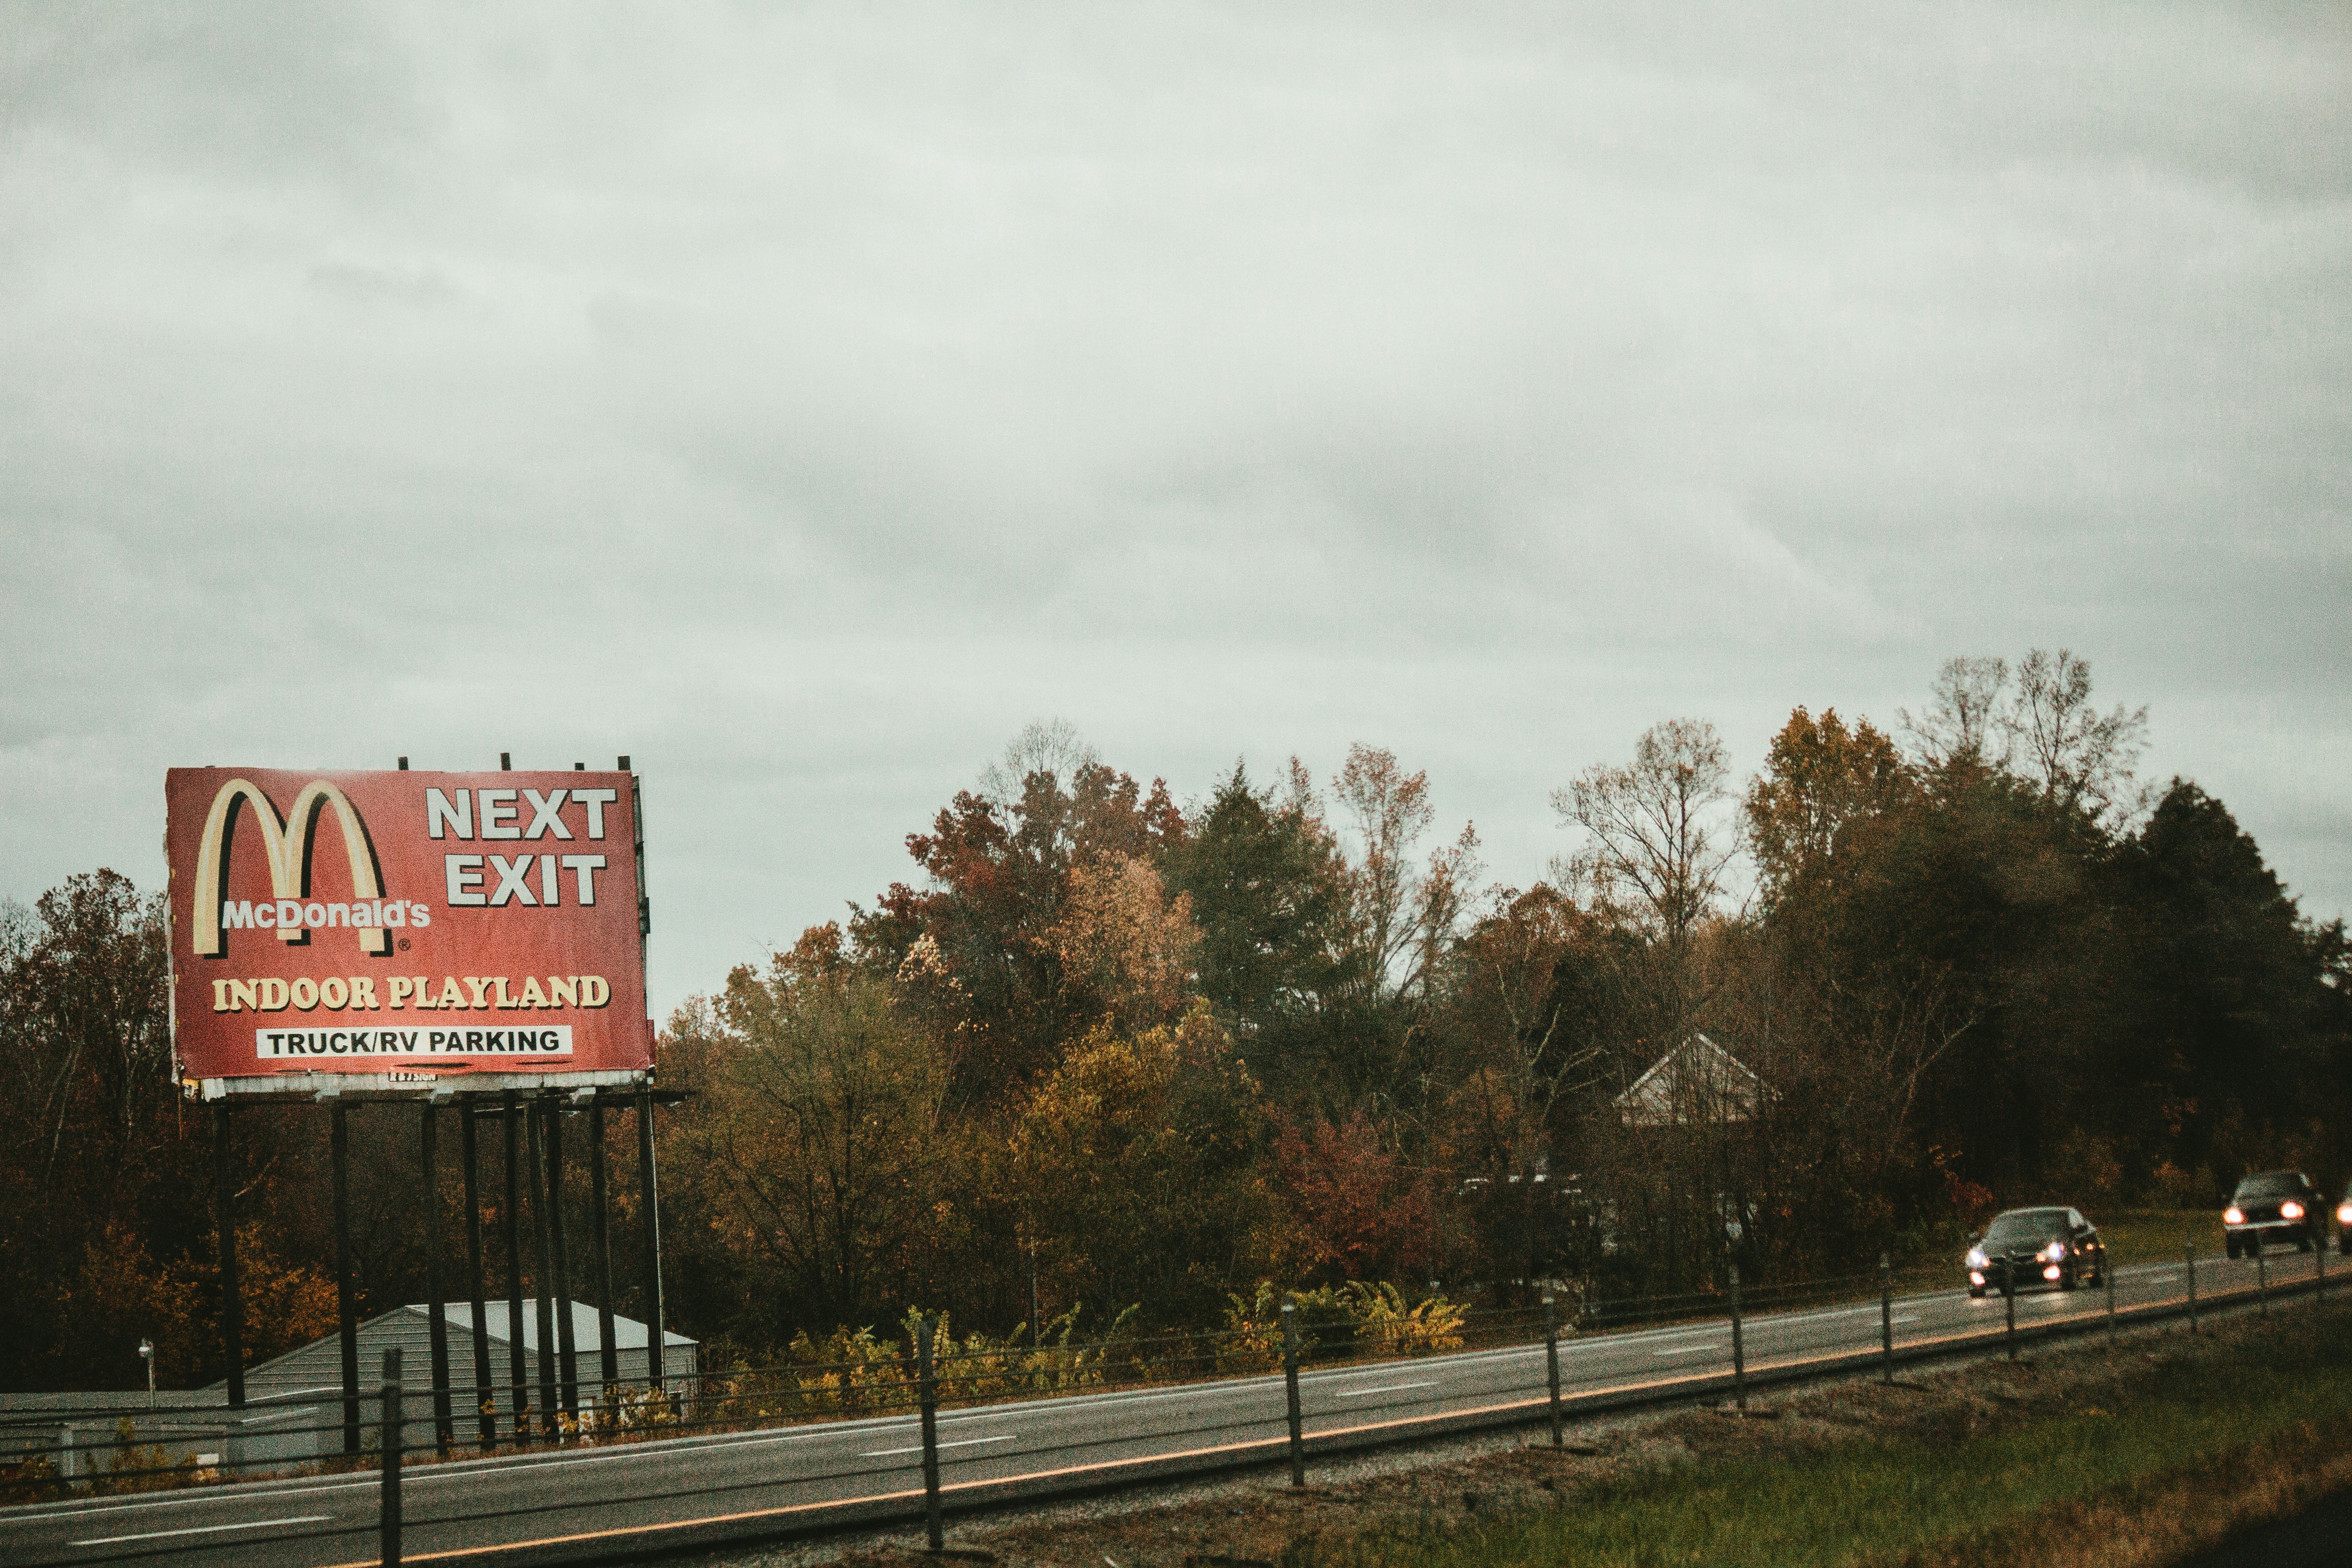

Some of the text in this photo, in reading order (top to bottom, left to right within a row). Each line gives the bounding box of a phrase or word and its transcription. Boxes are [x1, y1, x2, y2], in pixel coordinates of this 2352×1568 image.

[426, 788, 617, 840] NEXT
[445, 854, 608, 907] EXIT
[222, 900, 431, 929] McDonald's
[212, 975, 612, 1012] INDOOR PLAYLAND
[267, 1030, 560, 1054] TRUCK/RV PARKING
